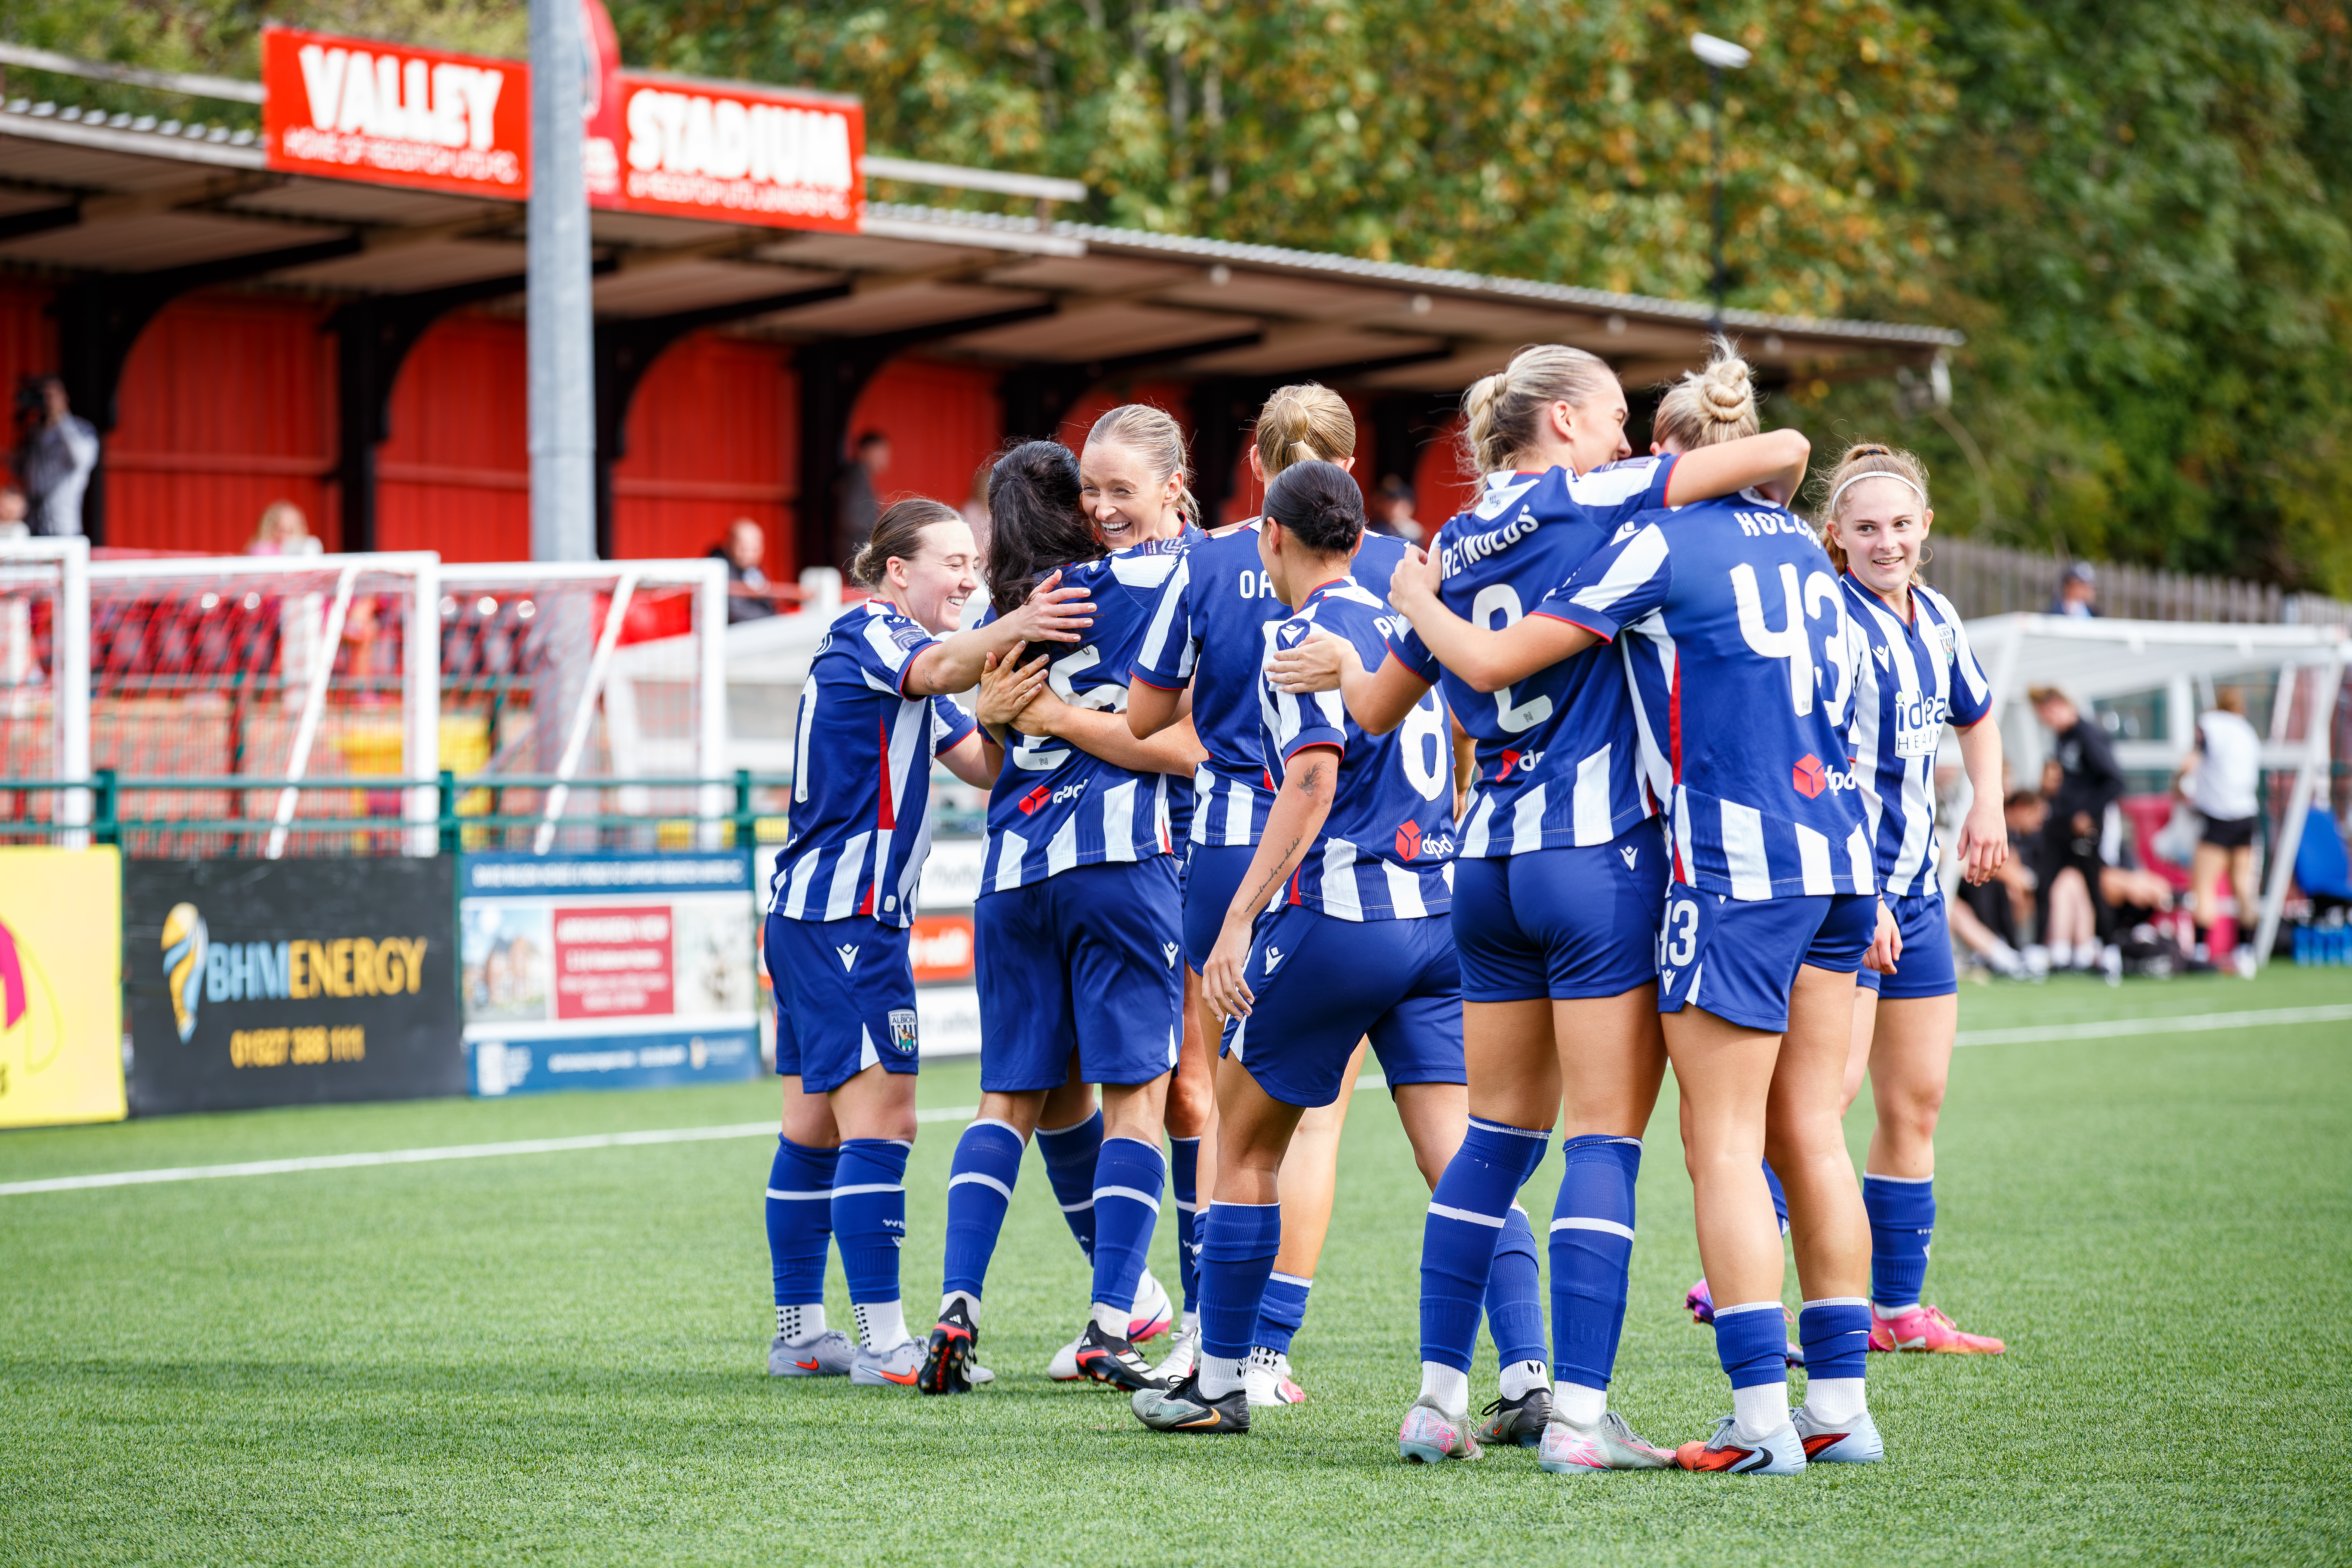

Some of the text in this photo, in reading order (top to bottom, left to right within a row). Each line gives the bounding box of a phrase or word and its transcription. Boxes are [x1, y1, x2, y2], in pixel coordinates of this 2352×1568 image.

[300, 45, 503, 149] VALLEY
[628, 89, 853, 189] STADIUM
[1730, 562, 1852, 727] 43
[1400, 685, 1447, 802] 8
[1897, 690, 1946, 732] idea
[1422, 833, 1454, 860] dpd
